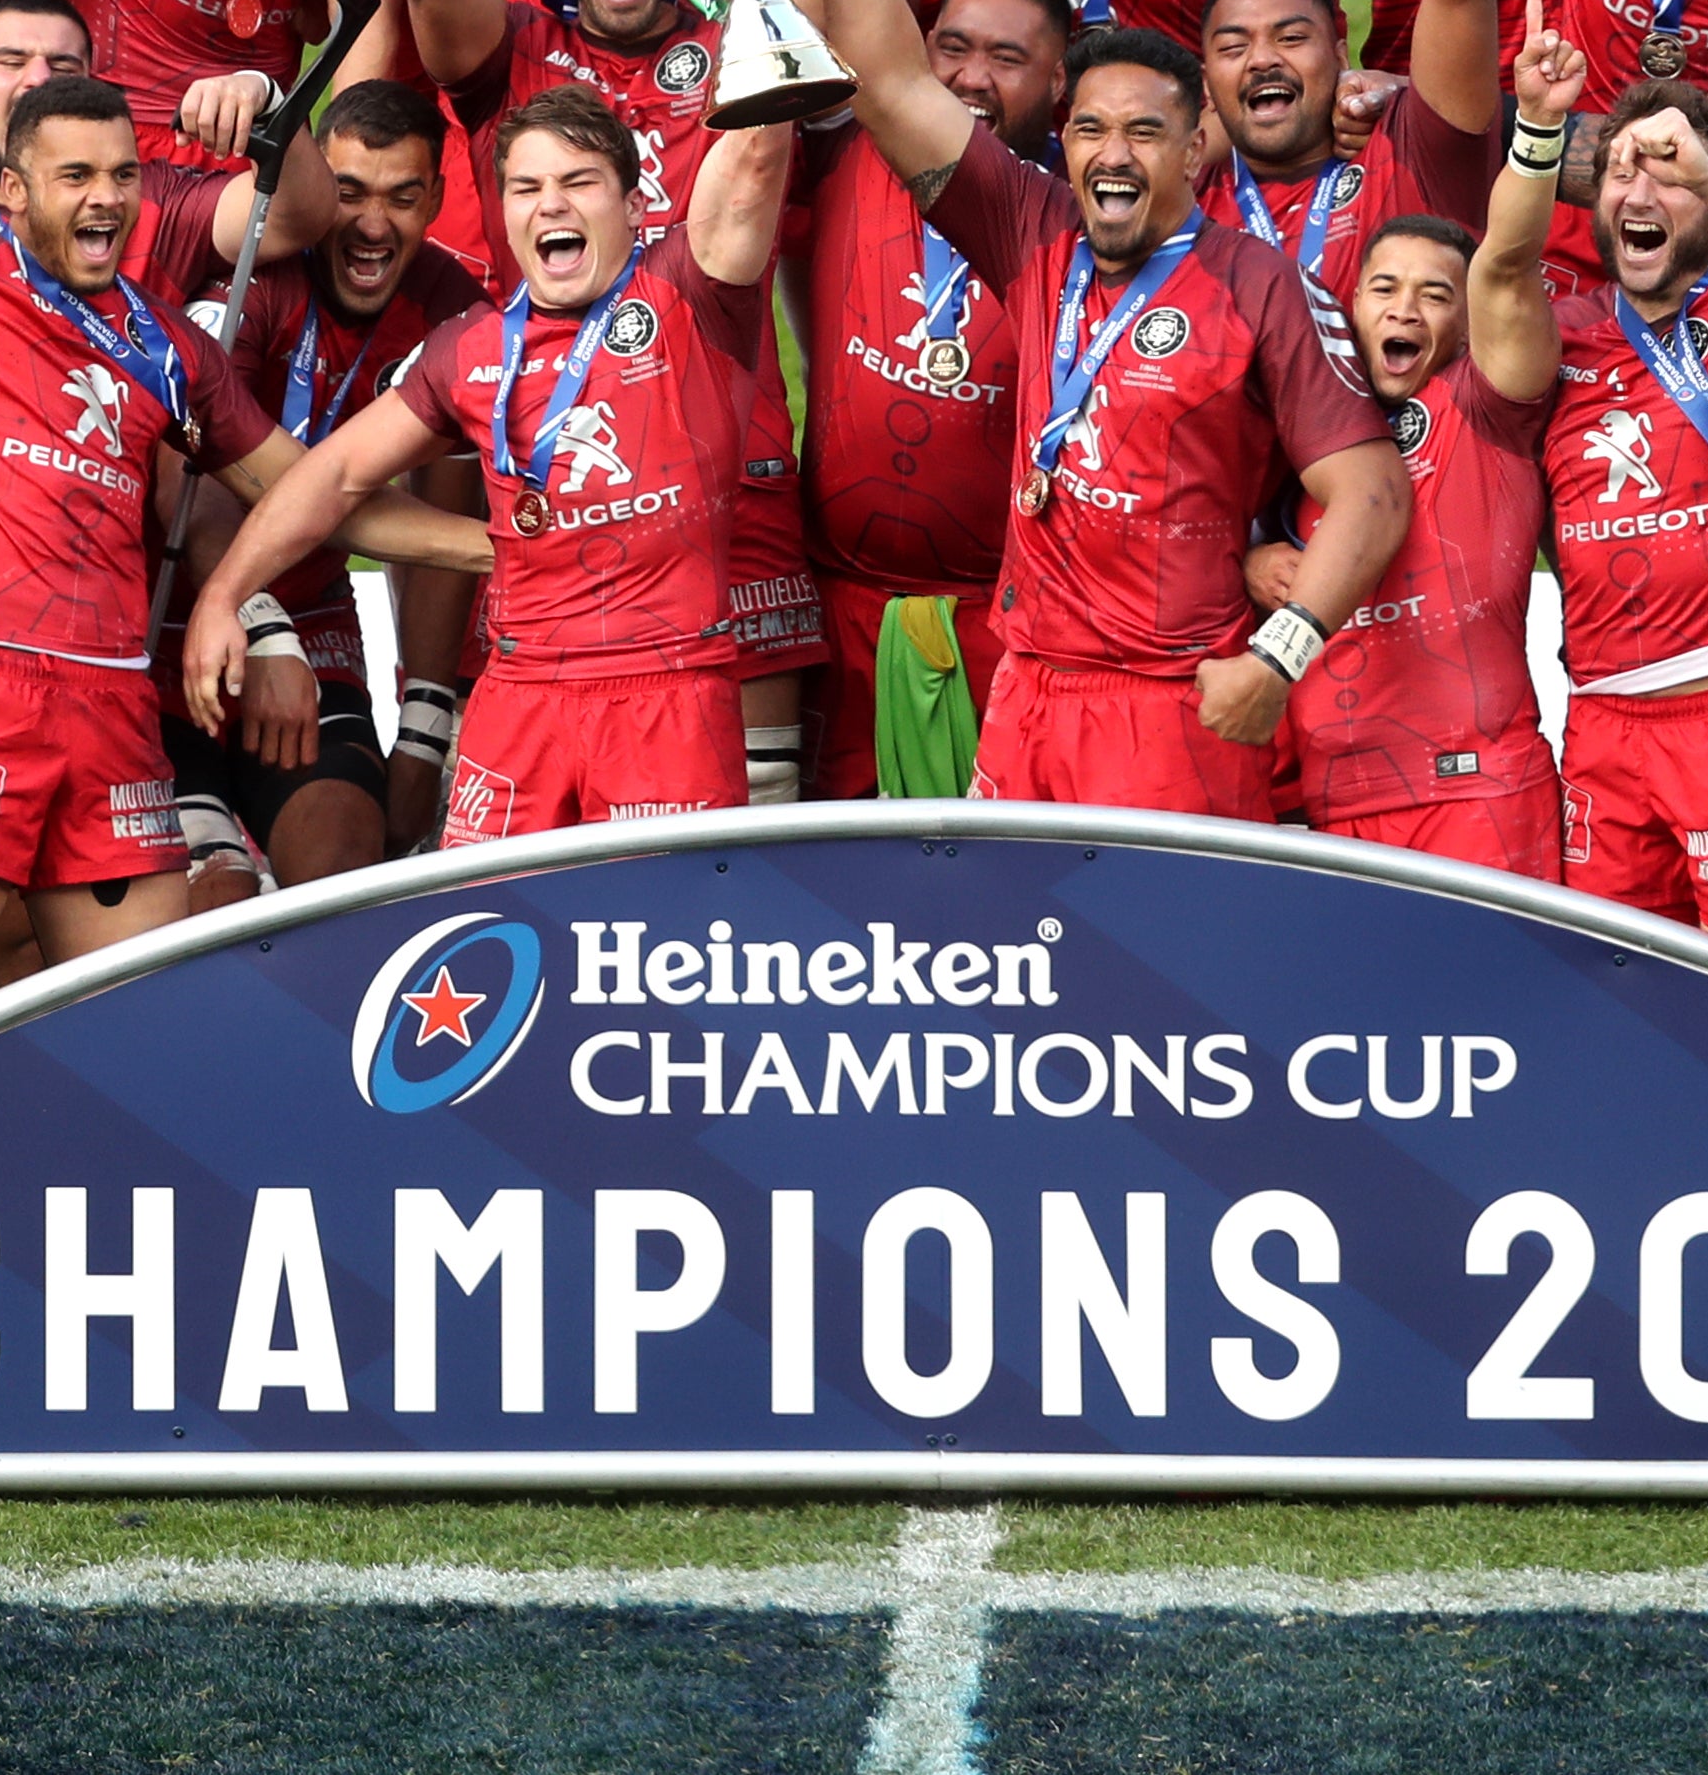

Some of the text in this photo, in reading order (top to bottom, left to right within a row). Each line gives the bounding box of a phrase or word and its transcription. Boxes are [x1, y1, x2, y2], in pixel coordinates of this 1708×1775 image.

[1, 437, 141, 500] PEUGEOT
[571, 920, 1059, 1008] Heineken
[571, 1031, 1518, 1120] CHAMPIONS CUP
